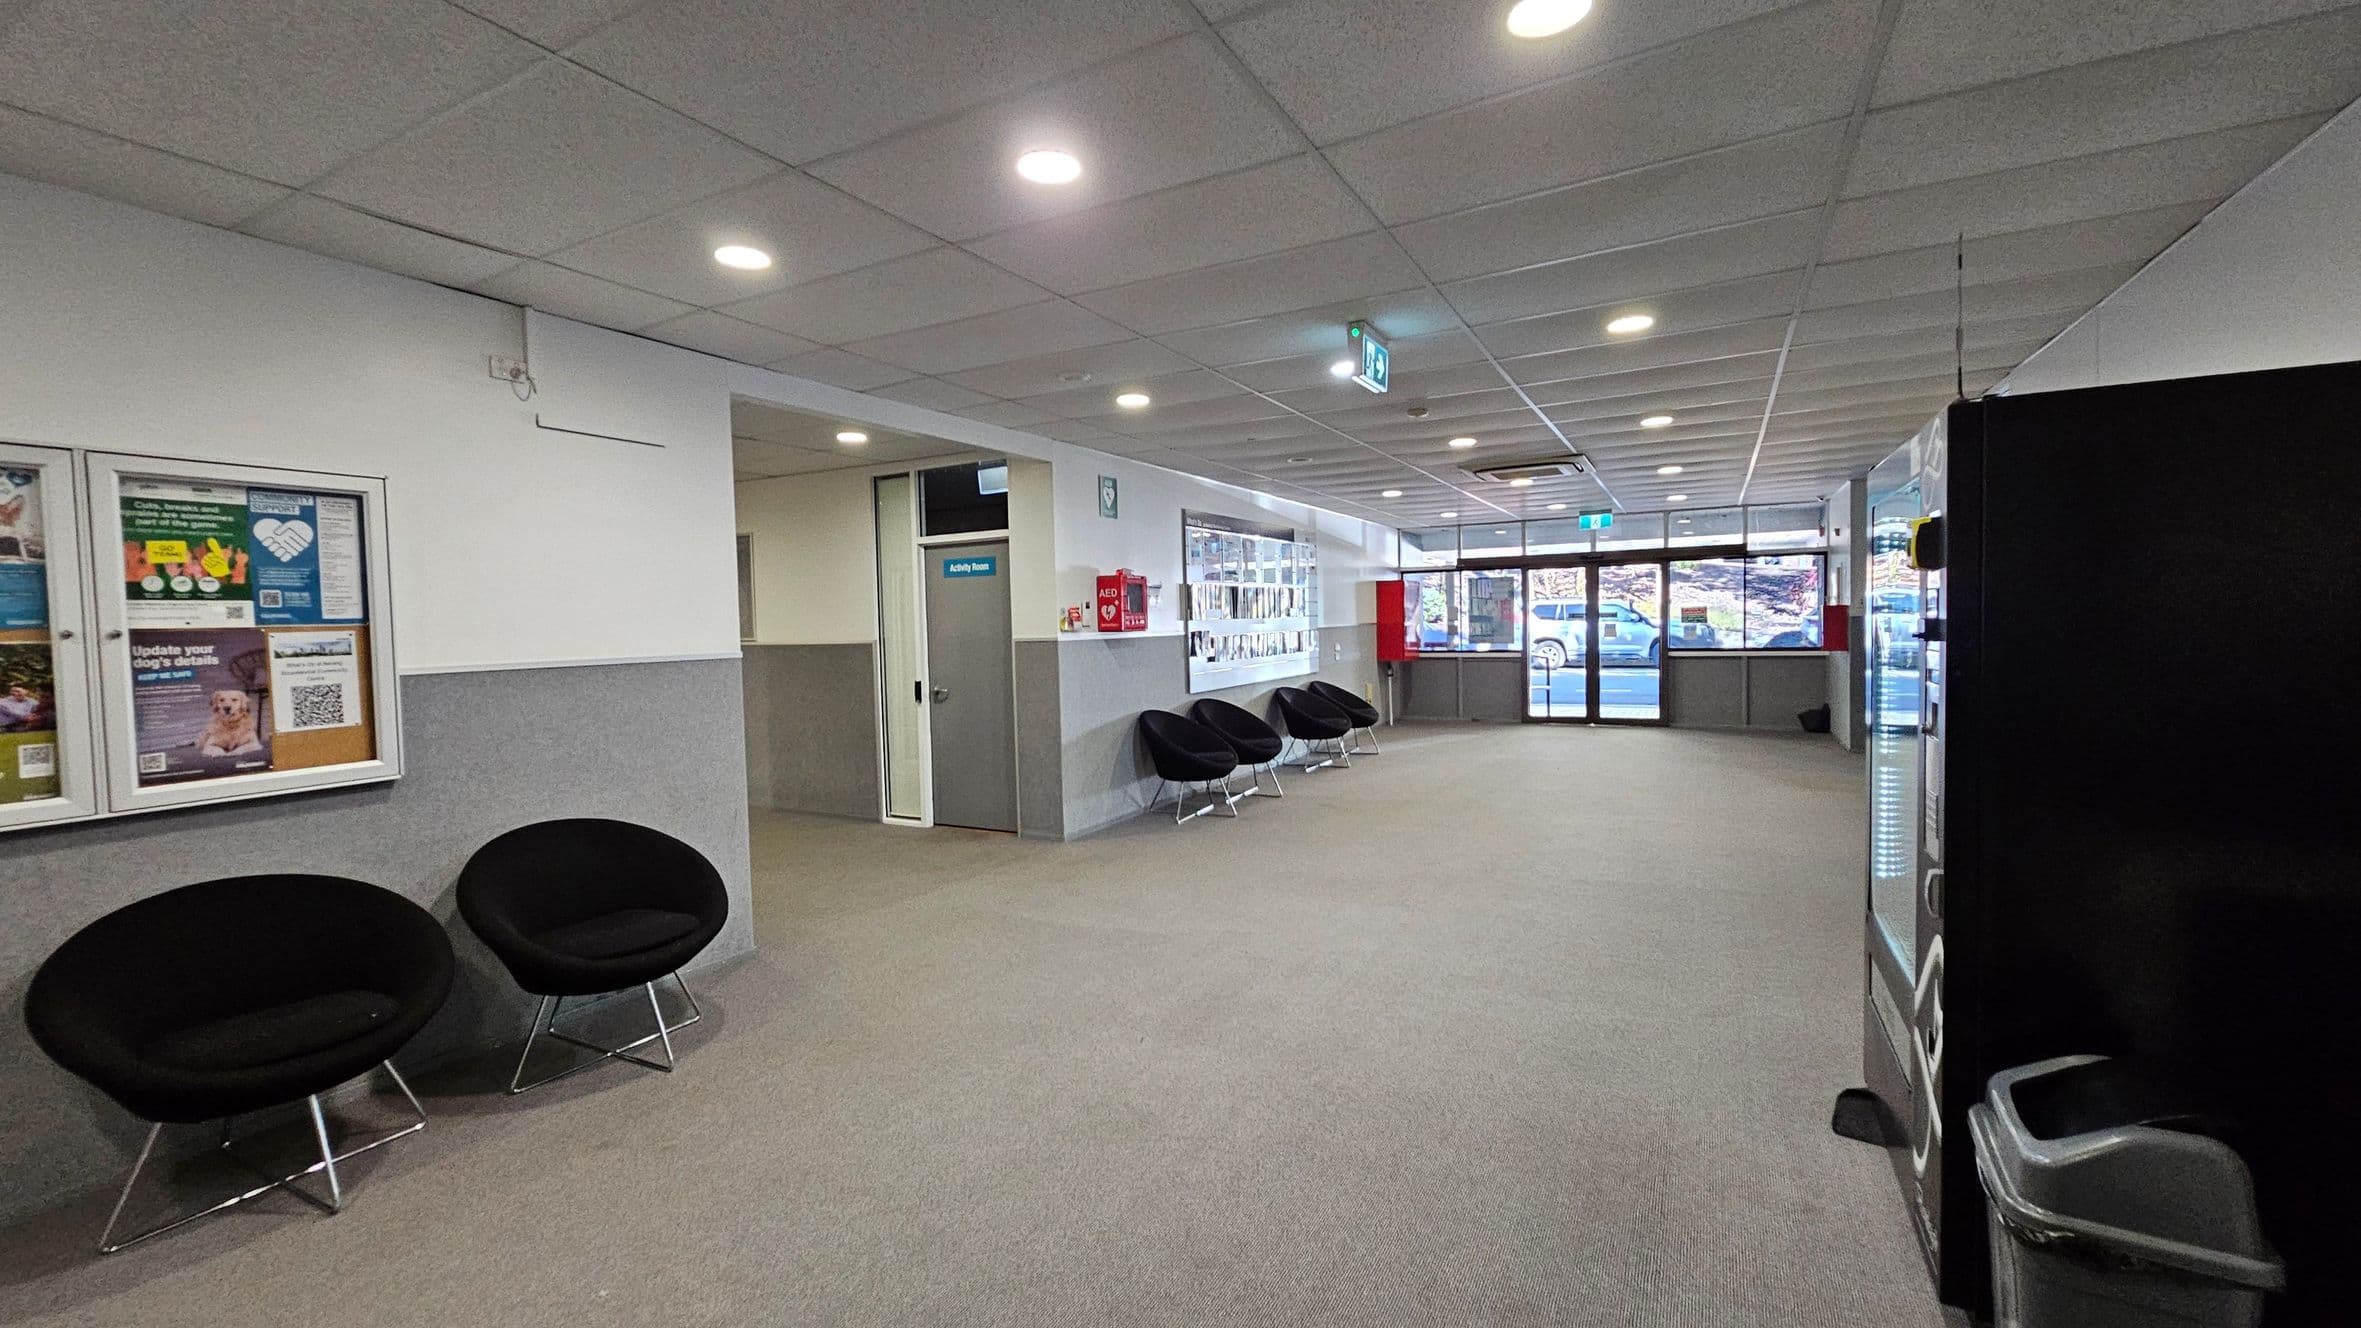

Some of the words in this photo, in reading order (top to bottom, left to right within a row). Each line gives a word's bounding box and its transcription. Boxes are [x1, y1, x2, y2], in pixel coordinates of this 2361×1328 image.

[250, 492, 313, 504] COMMUNITY
[164, 504, 199, 512] breaks
[251, 503, 298, 513] SUPPORT
[180, 513, 234, 522] sometimes
[135, 518, 157, 526] part
[171, 520, 189, 528] the
[190, 521, 219, 529] game.
[950, 563, 971, 574] Activity
[972, 562, 990, 571] Room
[1099, 588, 1118, 598] AED
[132, 645, 182, 657] Update
[184, 646, 215, 656] your
[133, 657, 172, 670] dog's
[174, 655, 220, 667] details
